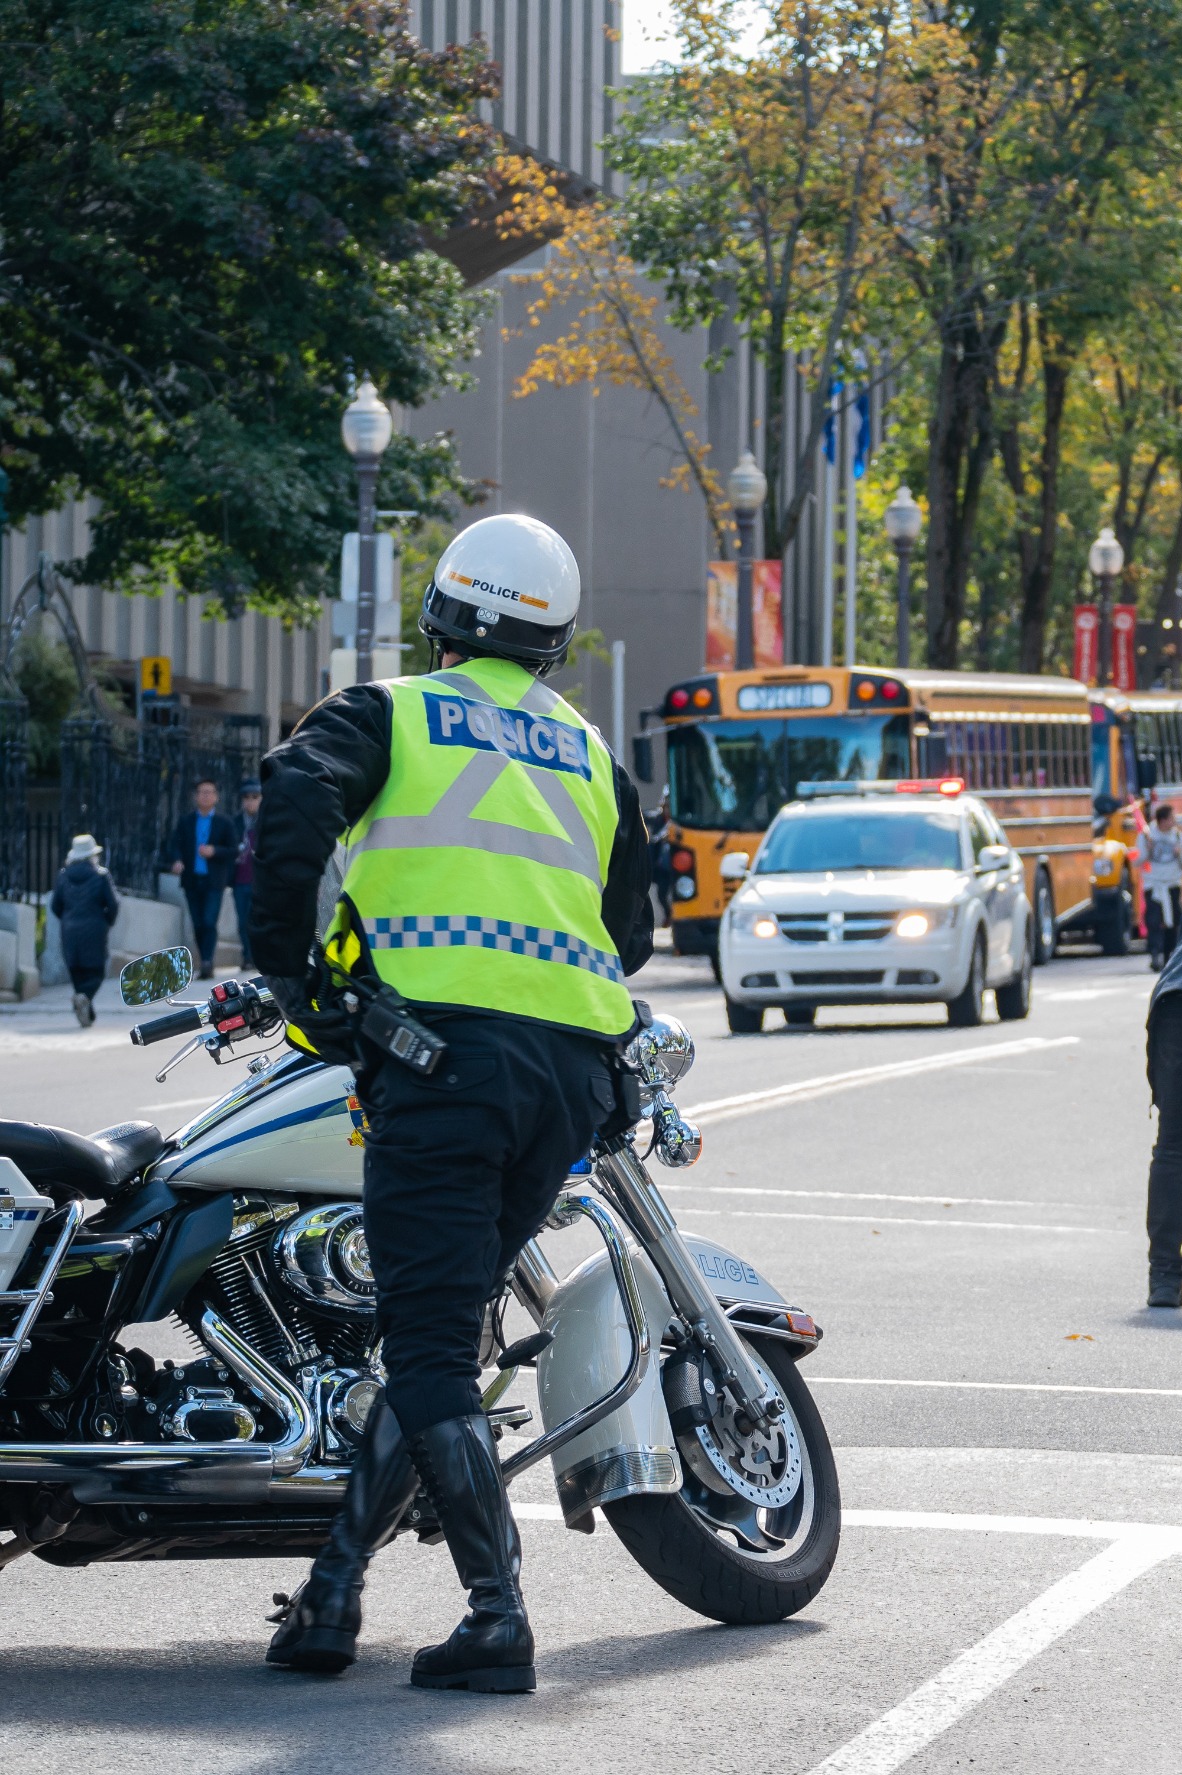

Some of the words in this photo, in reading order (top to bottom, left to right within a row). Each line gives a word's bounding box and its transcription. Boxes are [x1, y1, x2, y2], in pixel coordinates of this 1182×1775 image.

[471, 578, 520, 602] POLICE
[478, 607, 499, 621] DOT
[438, 699, 581, 768] POLICE
[691, 1252, 760, 1286] LICE
[777, 1567, 803, 1579] ELITE
